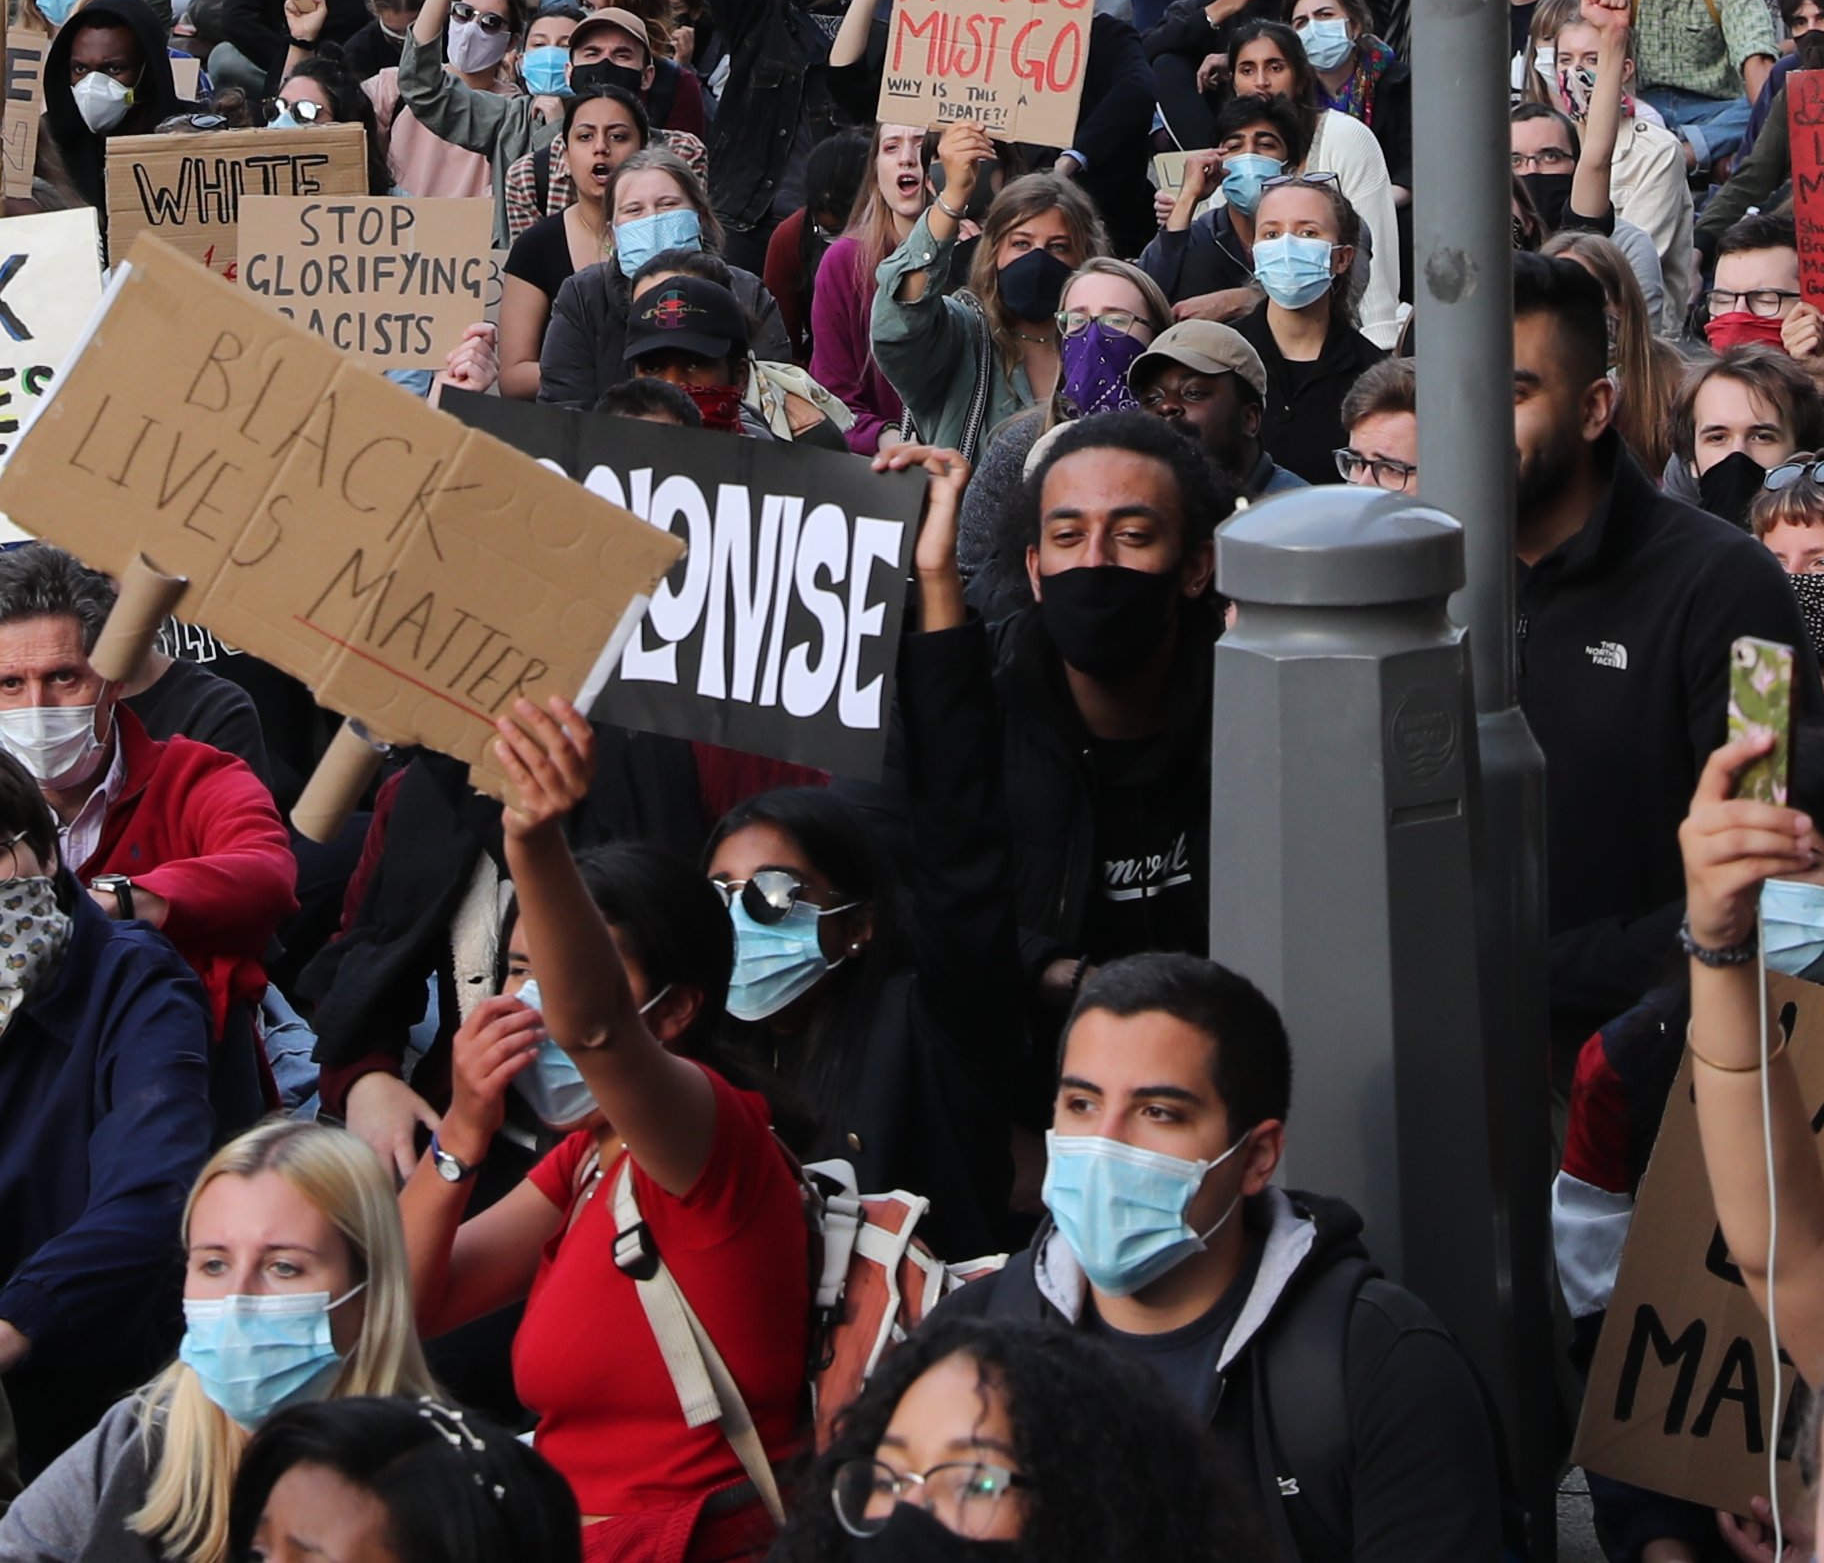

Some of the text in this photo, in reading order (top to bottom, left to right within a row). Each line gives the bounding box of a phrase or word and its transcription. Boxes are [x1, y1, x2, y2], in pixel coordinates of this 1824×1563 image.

[892, 8, 1083, 93] MUST GO
[887, 77, 1028, 105] WHY IS THIS A
[938, 101, 1008, 125] DEBATE?!
[133, 154, 329, 226] WHITE
[299, 204, 415, 246] STOP
[246, 253, 482, 298] GLORIFYING
[185, 331, 482, 561] BLACK
[69, 395, 292, 566] LIVES
[305, 548, 548, 713] MATTER
[1585, 646, 1616, 657] NORTH
[1600, 640, 1617, 649] THE
[1592, 655, 1616, 667] FACE
